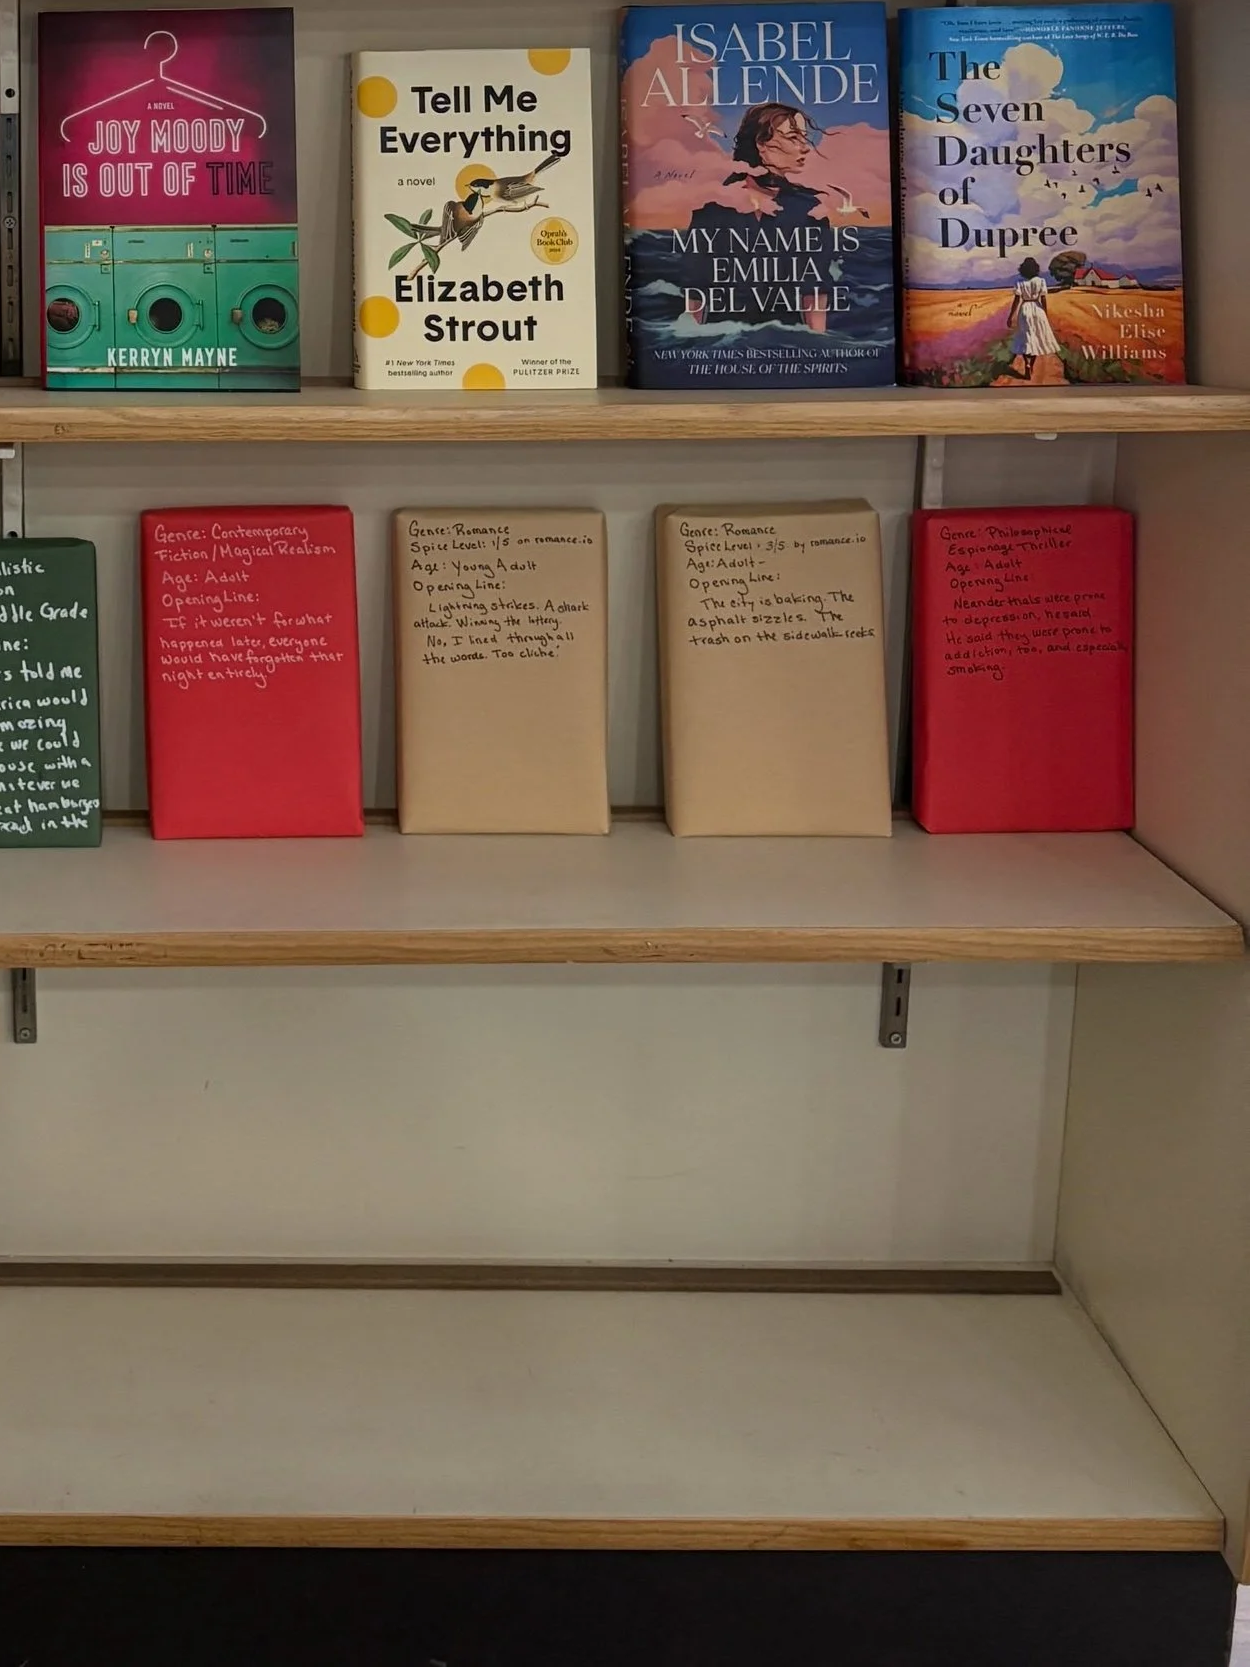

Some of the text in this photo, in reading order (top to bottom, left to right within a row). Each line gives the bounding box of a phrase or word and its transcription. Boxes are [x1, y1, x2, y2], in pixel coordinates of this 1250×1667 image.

[674, 22, 852, 64] ISABEL
[929, 52, 1001, 82] The
[411, 85, 538, 114] Tell Me
[641, 63, 880, 108] ALLENDE
[936, 93, 1044, 124] Seven
[88, 119, 244, 154] JOY MOODY
[380, 124, 572, 158] Everything
[937, 135, 1131, 176] Daughters
[63, 161, 275, 198] IS OUT OF TIME
[938, 177, 976, 207] of
[671, 227, 859, 254] MY NAME IS
[939, 219, 1078, 258] Dupree
[713, 258, 821, 283] EMILIA
[395, 274, 565, 303] Elizabeth
[683, 286, 850, 314] DEL VALLE
[1092, 303, 1165, 320] Nikesha
[424, 313, 538, 342] Strout
[1119, 323, 1165, 339] Elise
[107, 347, 237, 368] KERRYN MAYNE
[1082, 342, 1167, 361] Williams
[453, 523, 509, 535] Romance
[688, 613, 806, 630] asphalt sizzles.
